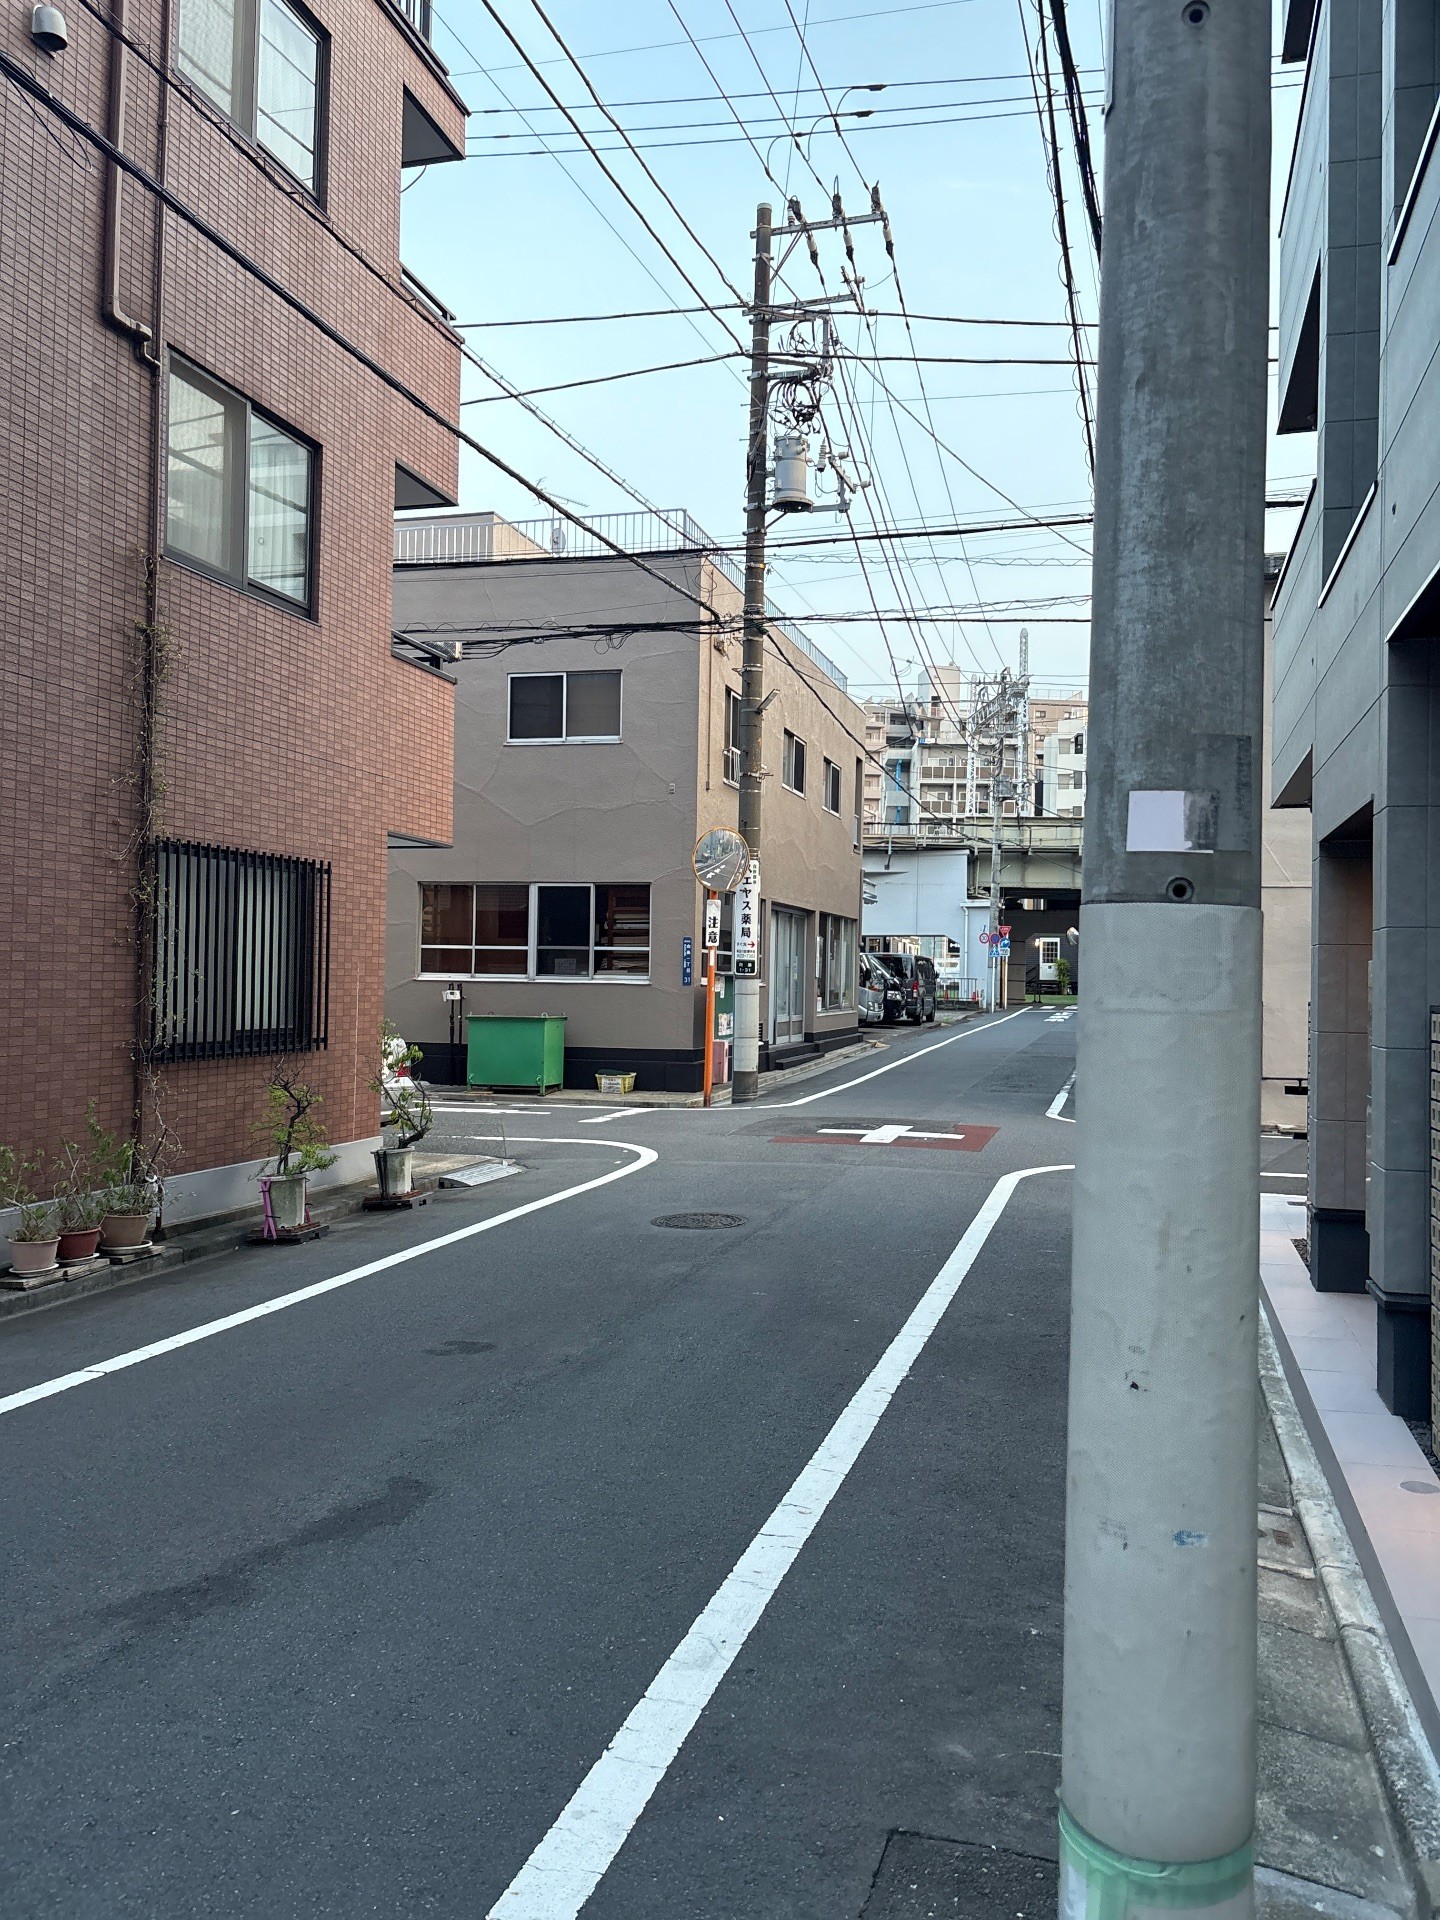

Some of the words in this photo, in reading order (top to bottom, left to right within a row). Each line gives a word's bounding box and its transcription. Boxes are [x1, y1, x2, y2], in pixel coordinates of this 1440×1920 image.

[739, 863, 752, 938] エヤス薬局
[708, 916, 718, 943] 注意
